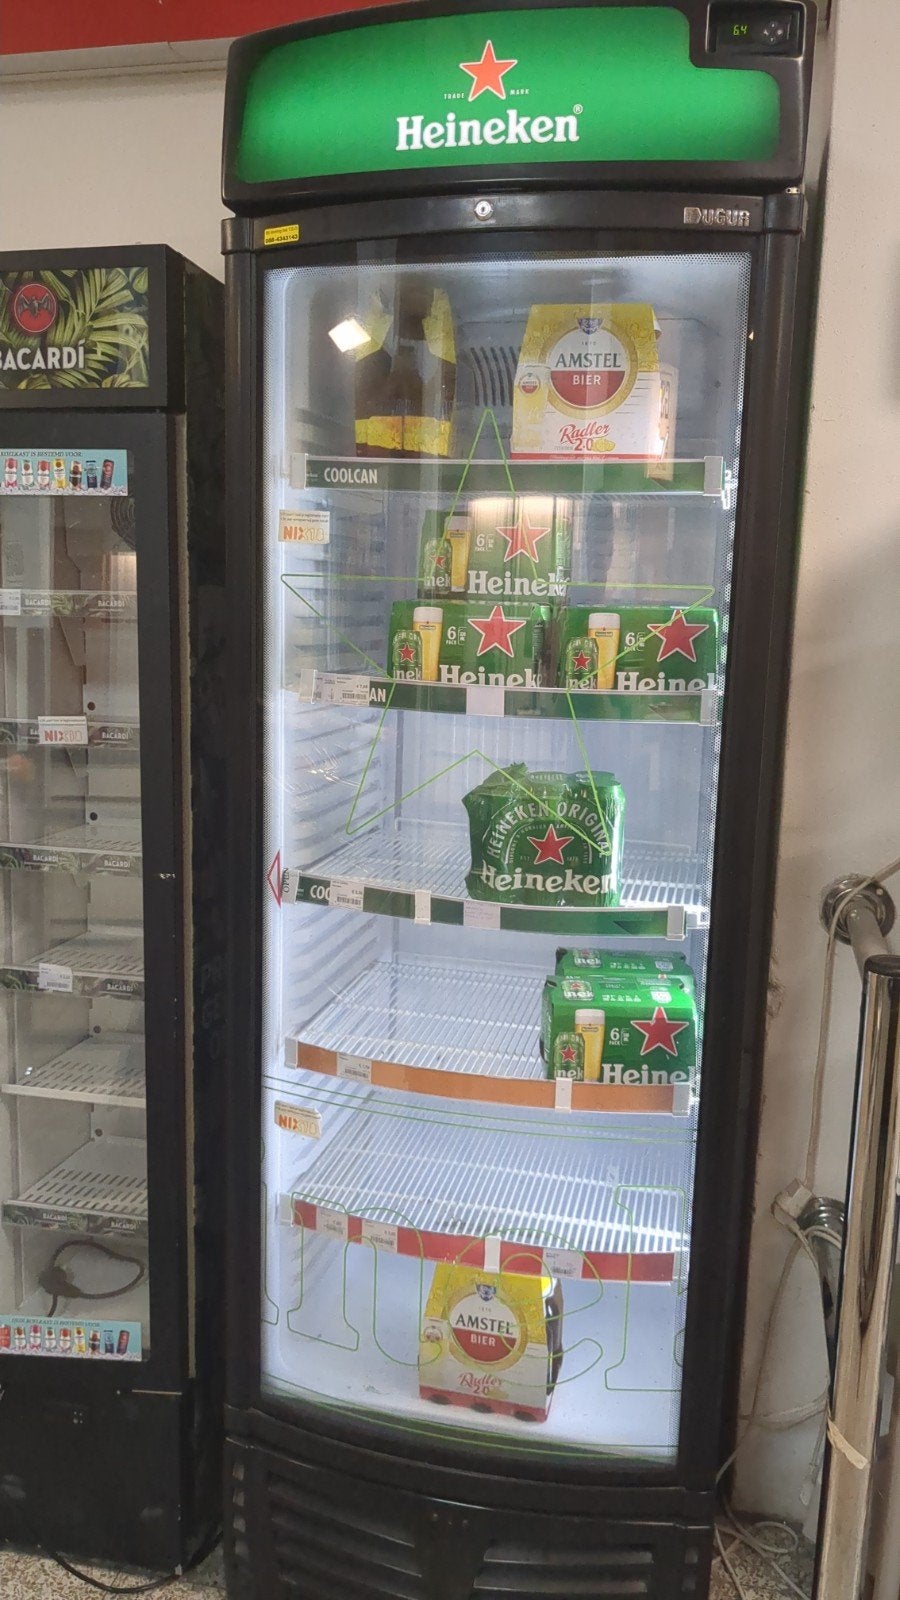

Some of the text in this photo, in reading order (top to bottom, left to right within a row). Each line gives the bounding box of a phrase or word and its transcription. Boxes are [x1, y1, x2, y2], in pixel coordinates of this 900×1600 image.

[443, 88, 530, 100] TRADE MARK
[555, 352, 622, 369] AMSTEL
[572, 374, 602, 386] BIER
[559, 421, 611, 445] Radler
[324, 467, 378, 484] COOLCAN
[476, 533, 485, 547] 6
[447, 626, 457, 640] 6
[625, 632, 636, 646] 6
[488, 800, 550, 859] HEINEKEN
[282, 867, 290, 893] OPEN
[610, 1027, 621, 1041] 6
[455, 1313, 515, 1336] AMSTEL
[470, 1333, 496, 1347] BIER
